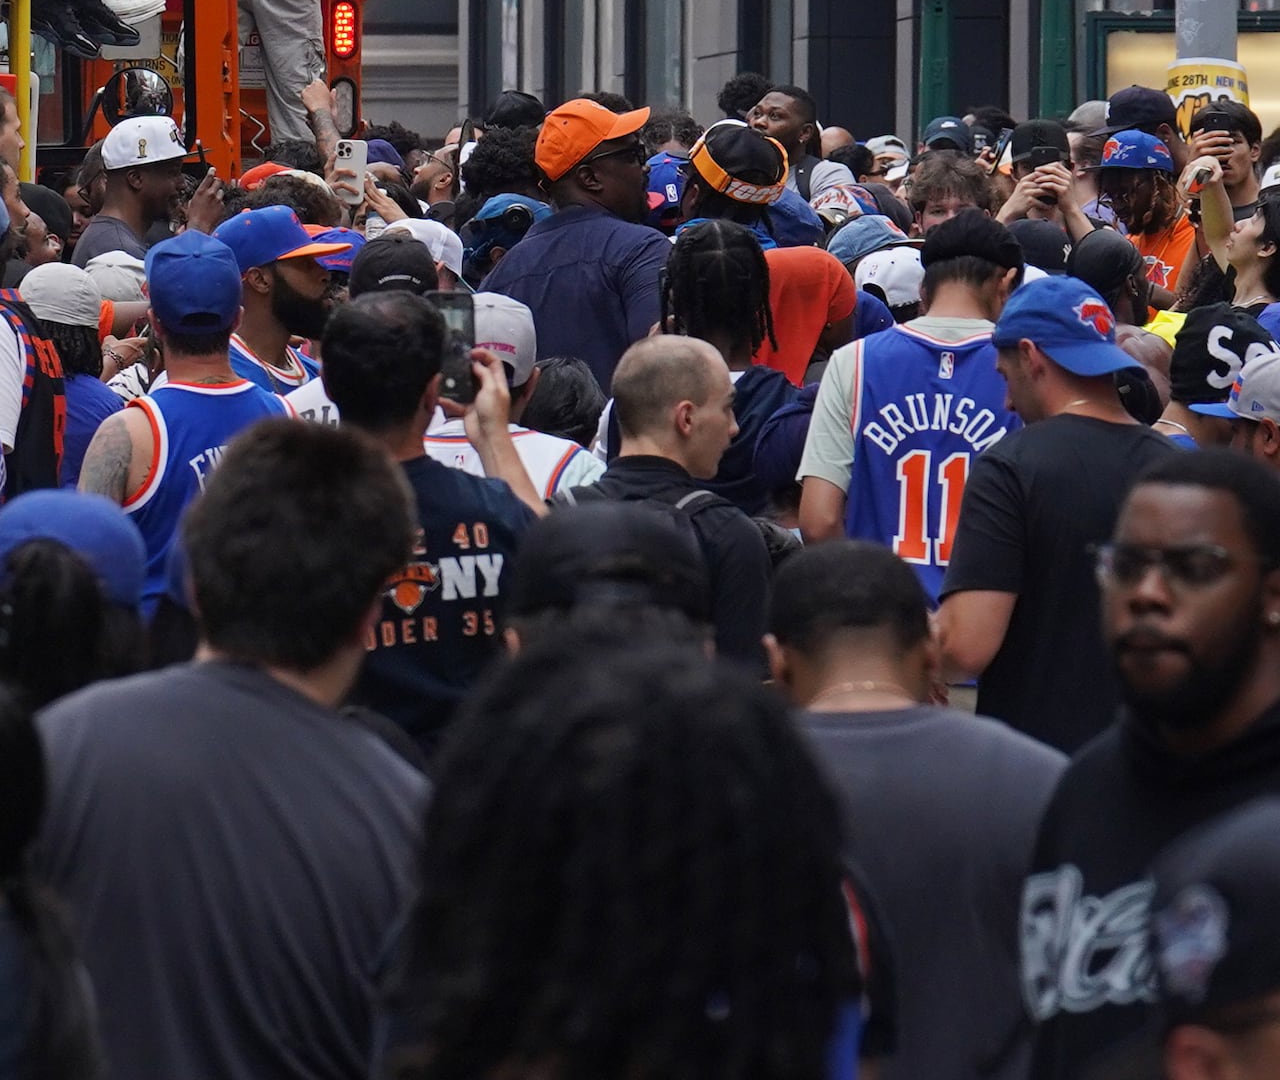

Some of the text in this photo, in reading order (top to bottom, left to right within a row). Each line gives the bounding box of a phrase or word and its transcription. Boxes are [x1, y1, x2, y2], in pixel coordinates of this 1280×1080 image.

[1182, 74, 1208, 88] 28TH
[1215, 75, 1234, 88] NEW
[892, 448, 970, 567] 11
[449, 522, 486, 549] 40
[436, 554, 500, 601] NY
[368, 610, 492, 648] DER 35
